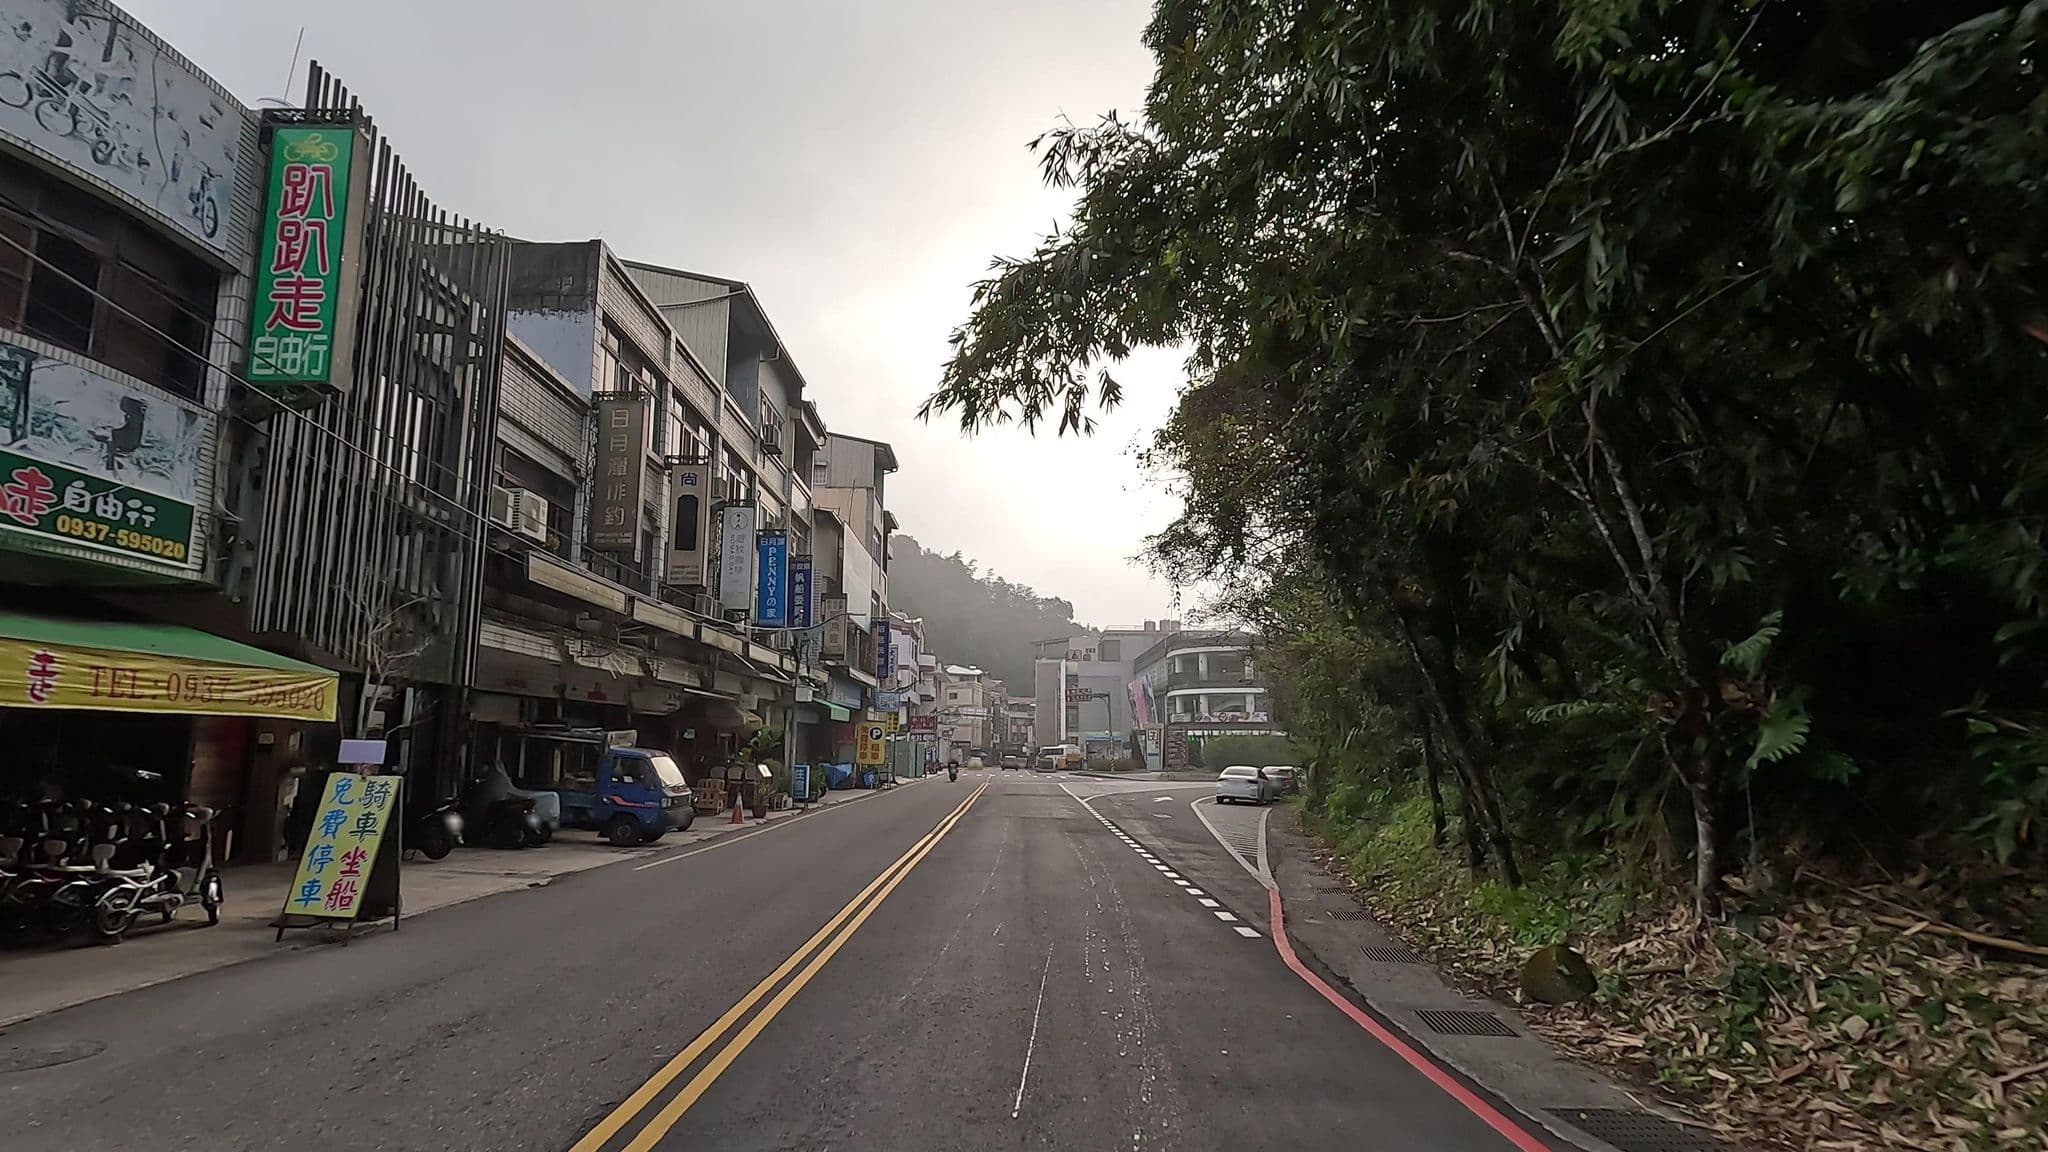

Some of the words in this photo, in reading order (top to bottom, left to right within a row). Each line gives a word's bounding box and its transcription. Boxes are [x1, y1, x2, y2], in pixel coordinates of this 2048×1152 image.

[265, 164, 335, 331] 趴趴走
[251, 333, 330, 376] 自由行
[64, 480, 157, 528] 自由行
[56, 515, 185, 560] 0937-595020
[872, 728, 881, 739] P
[294, 776, 355, 908] 免費停車
[324, 780, 392, 911] 騎車坐船
